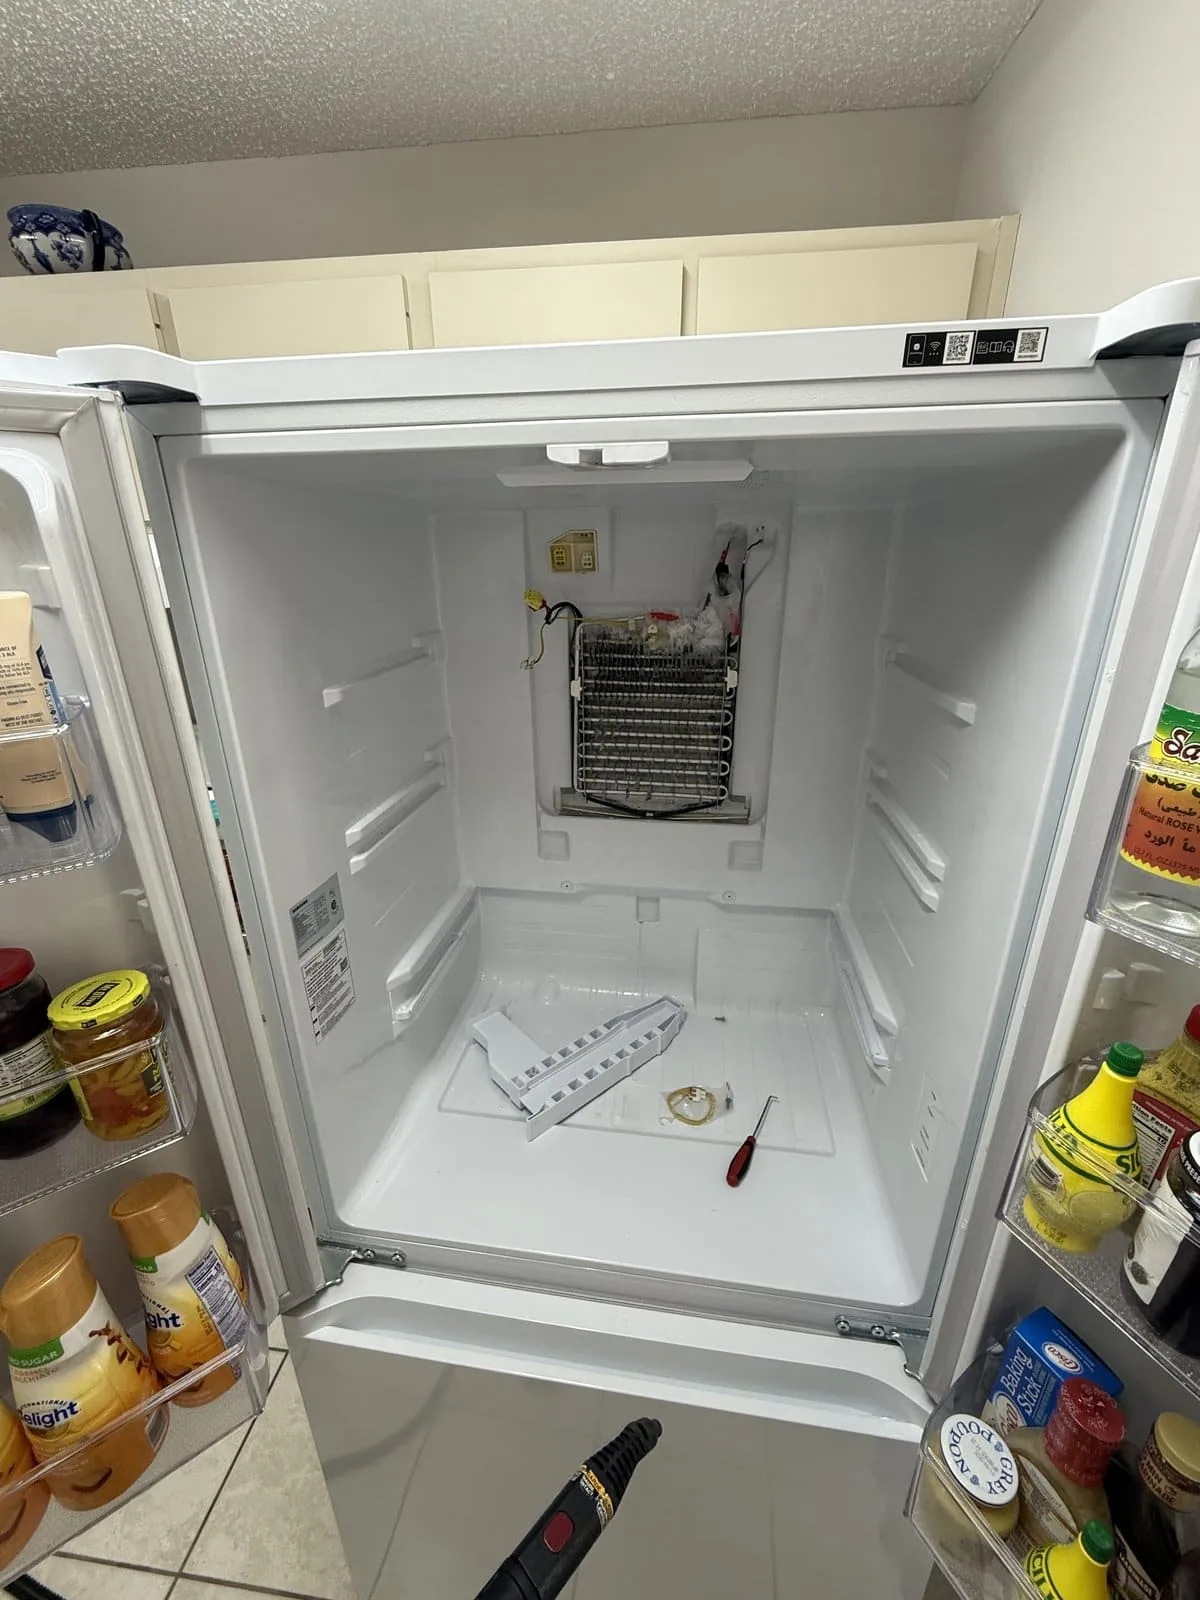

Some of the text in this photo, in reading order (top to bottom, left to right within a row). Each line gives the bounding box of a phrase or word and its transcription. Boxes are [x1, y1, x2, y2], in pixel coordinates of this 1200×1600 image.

[1139, 806, 1164, 824] Natural
[1166, 817, 1194, 832] ROSE
[20, 1350, 58, 1367] SUGAR
[1000, 1346, 1033, 1396] Baking
[1016, 1375, 1042, 1417] Stick
[949, 1420, 994, 1474] POUPON
[987, 1456, 1014, 1495] GREY
